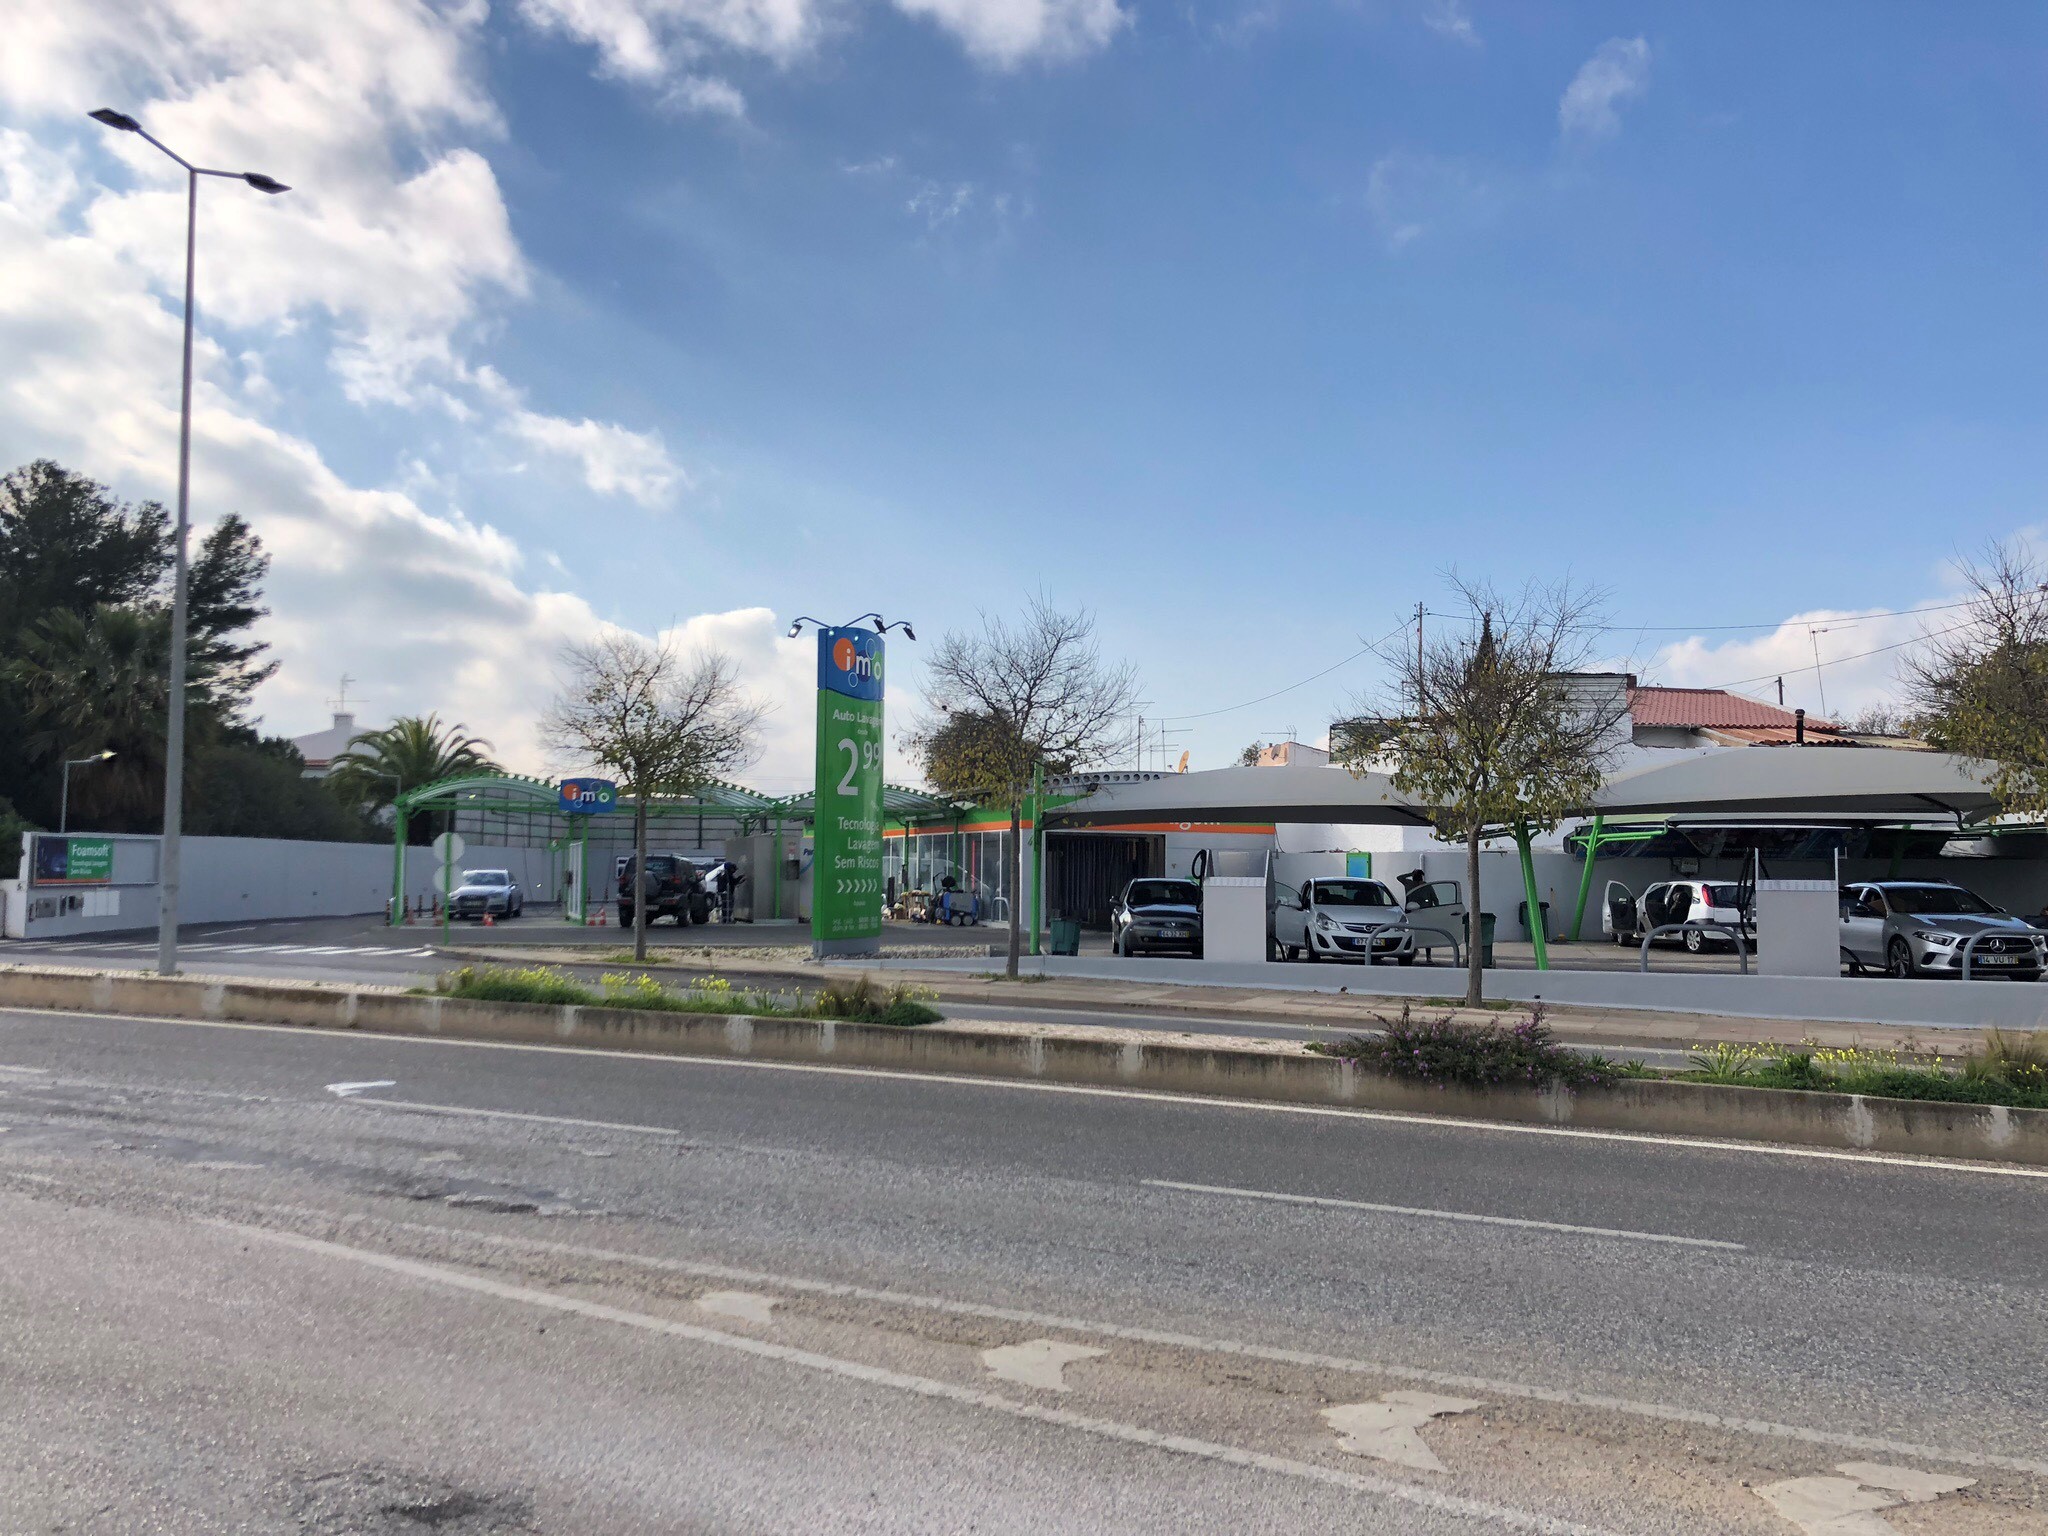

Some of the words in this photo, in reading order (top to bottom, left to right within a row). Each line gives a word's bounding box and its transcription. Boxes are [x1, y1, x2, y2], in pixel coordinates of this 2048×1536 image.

[846, 648, 881, 680] imo
[833, 709, 855, 721] Auto
[572, 788, 609, 803] imo
[72, 844, 109, 857] Foamsoft
[835, 855, 855, 868] Sem
